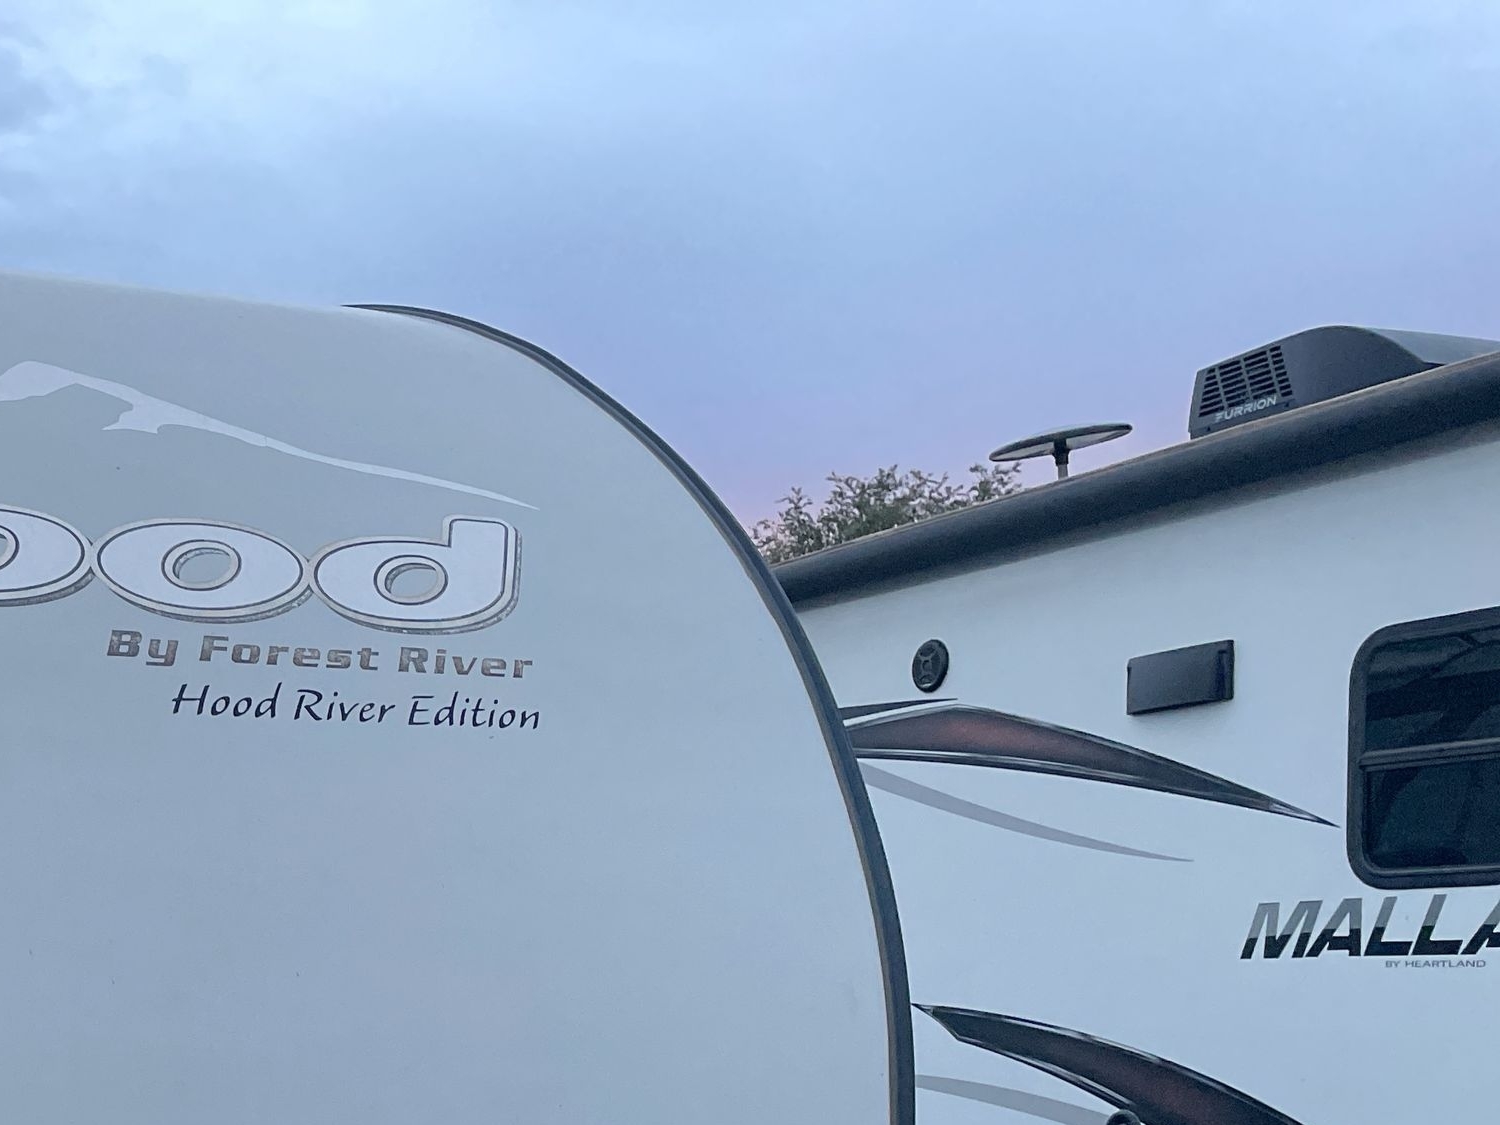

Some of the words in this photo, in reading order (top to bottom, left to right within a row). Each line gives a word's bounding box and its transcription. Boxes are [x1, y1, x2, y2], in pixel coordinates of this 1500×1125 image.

[1214, 395, 1277, 423] FURRION
[106, 629, 180, 667] By
[199, 634, 379, 671] Forest
[397, 645, 534, 679] River
[171, 682, 283, 719] Hood
[293, 687, 396, 724] River
[407, 691, 540, 730] Edition
[1385, 960, 1401, 968] BY
[1404, 959, 1486, 968] HEARTLAND
